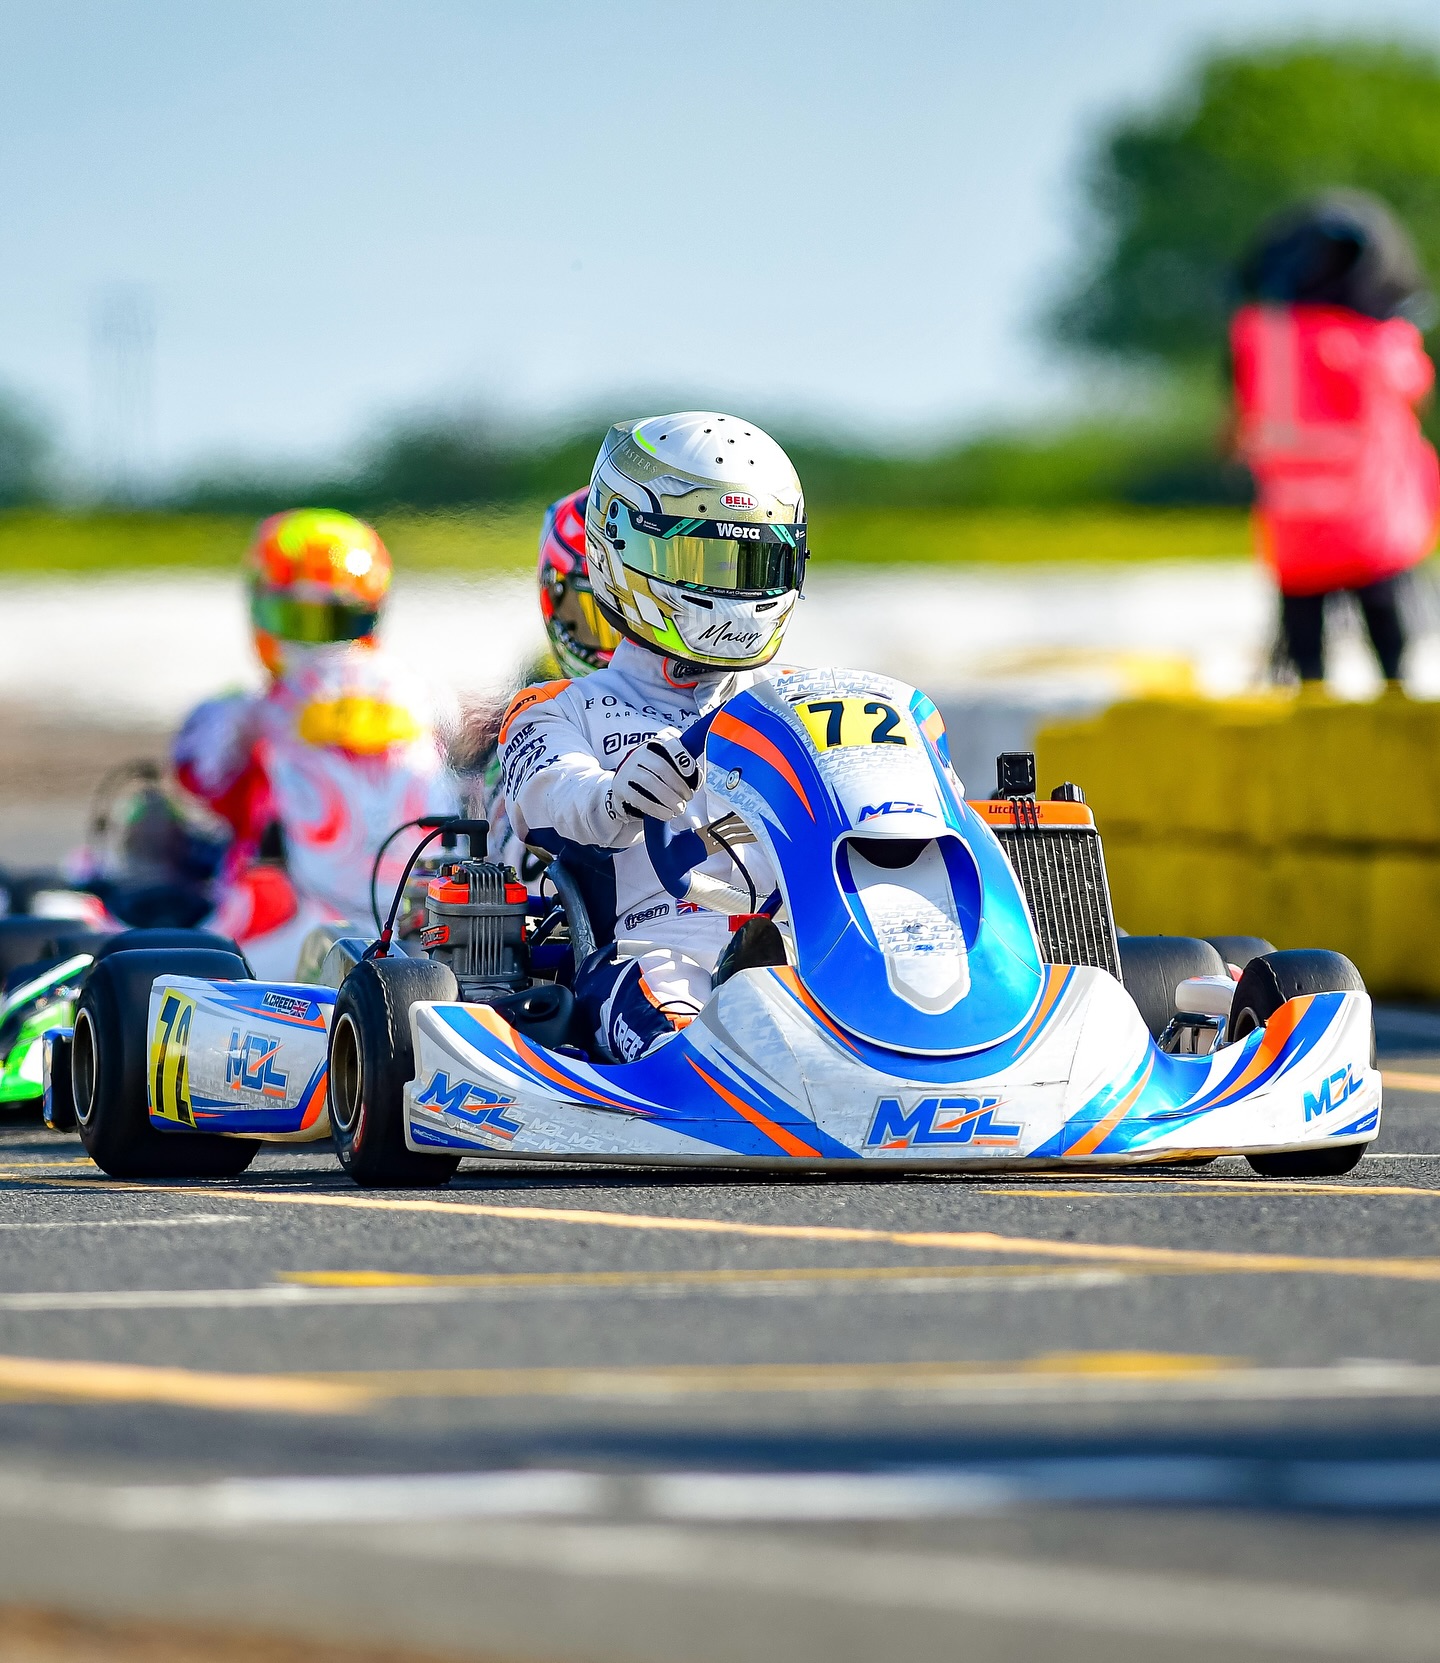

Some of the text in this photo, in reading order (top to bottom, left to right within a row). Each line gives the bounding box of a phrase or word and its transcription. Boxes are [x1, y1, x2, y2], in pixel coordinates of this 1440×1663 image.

[725, 495, 754, 506] BELL
[716, 522, 760, 540] Wera
[698, 620, 763, 650] Maisy
[807, 701, 908, 748] 72
[858, 801, 938, 823] MDL
[625, 904, 670, 931] freem
[156, 995, 192, 1124] 72
[225, 1028, 289, 1096] MDL
[416, 1070, 522, 1137] MDL
[1303, 1063, 1364, 1123] MDL
[864, 1095, 1024, 1148] MDL
